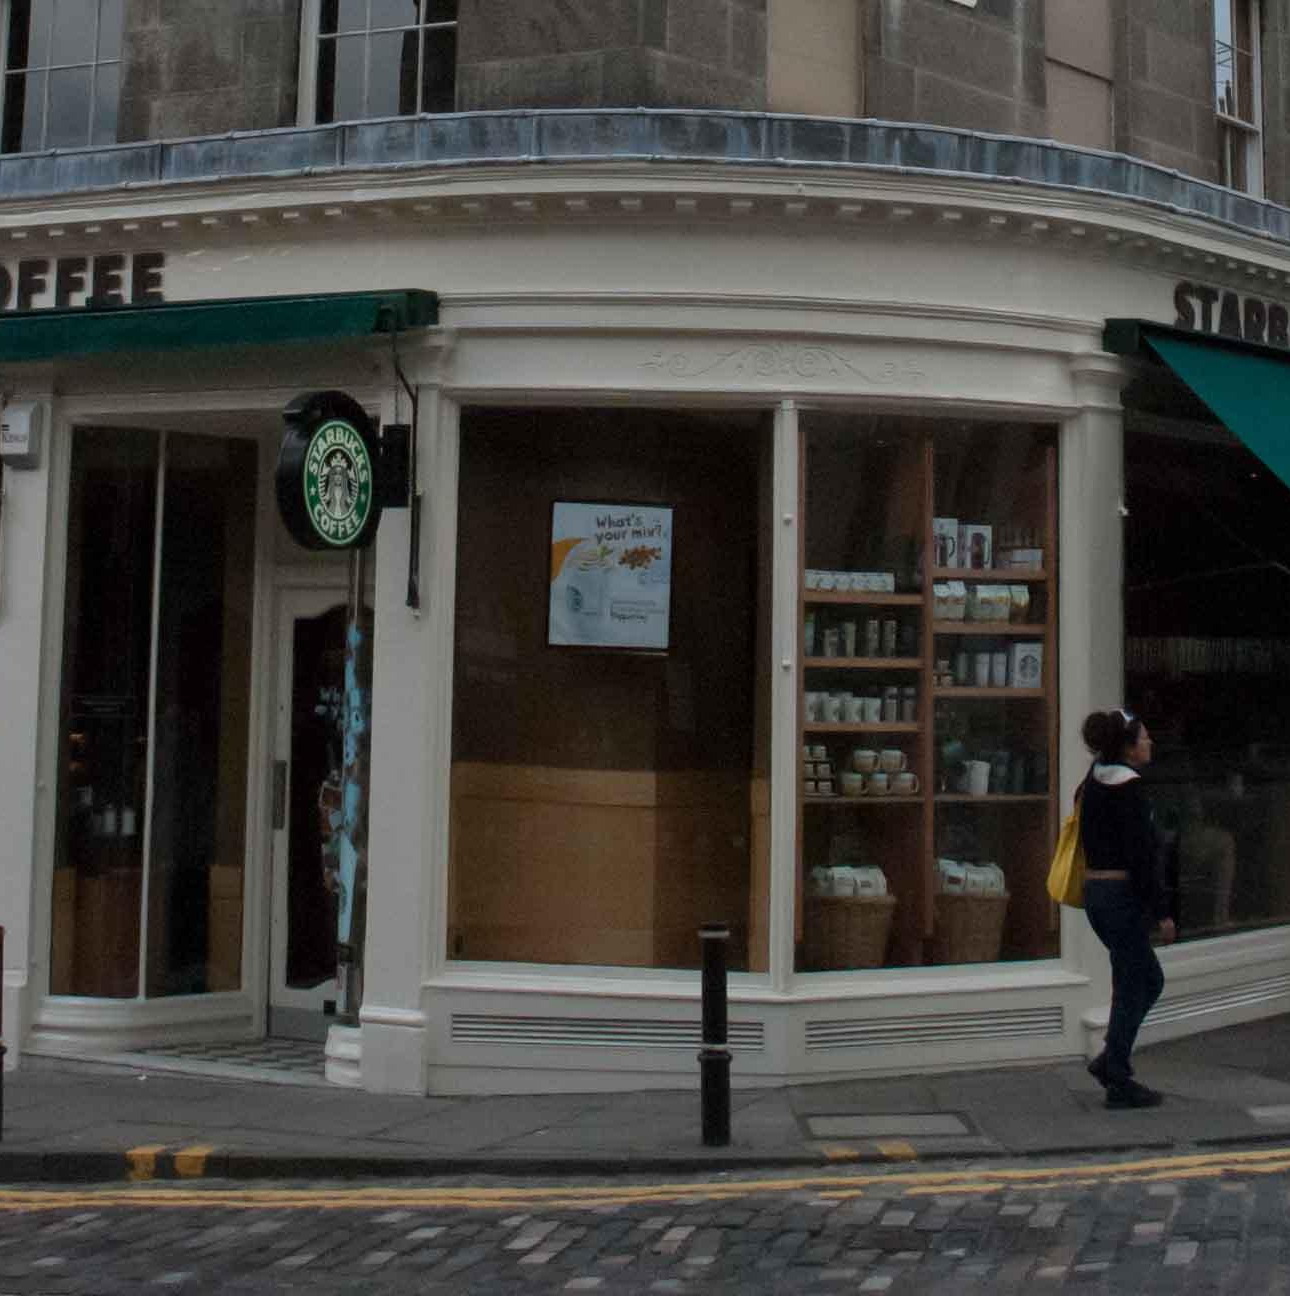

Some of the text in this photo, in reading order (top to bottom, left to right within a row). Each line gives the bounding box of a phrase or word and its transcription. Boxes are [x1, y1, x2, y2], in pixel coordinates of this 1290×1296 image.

[308, 426, 370, 483] STARBUCKS
[313, 503, 362, 538] COFFEE
[595, 512, 644, 529] What's
[593, 529, 629, 545] your
